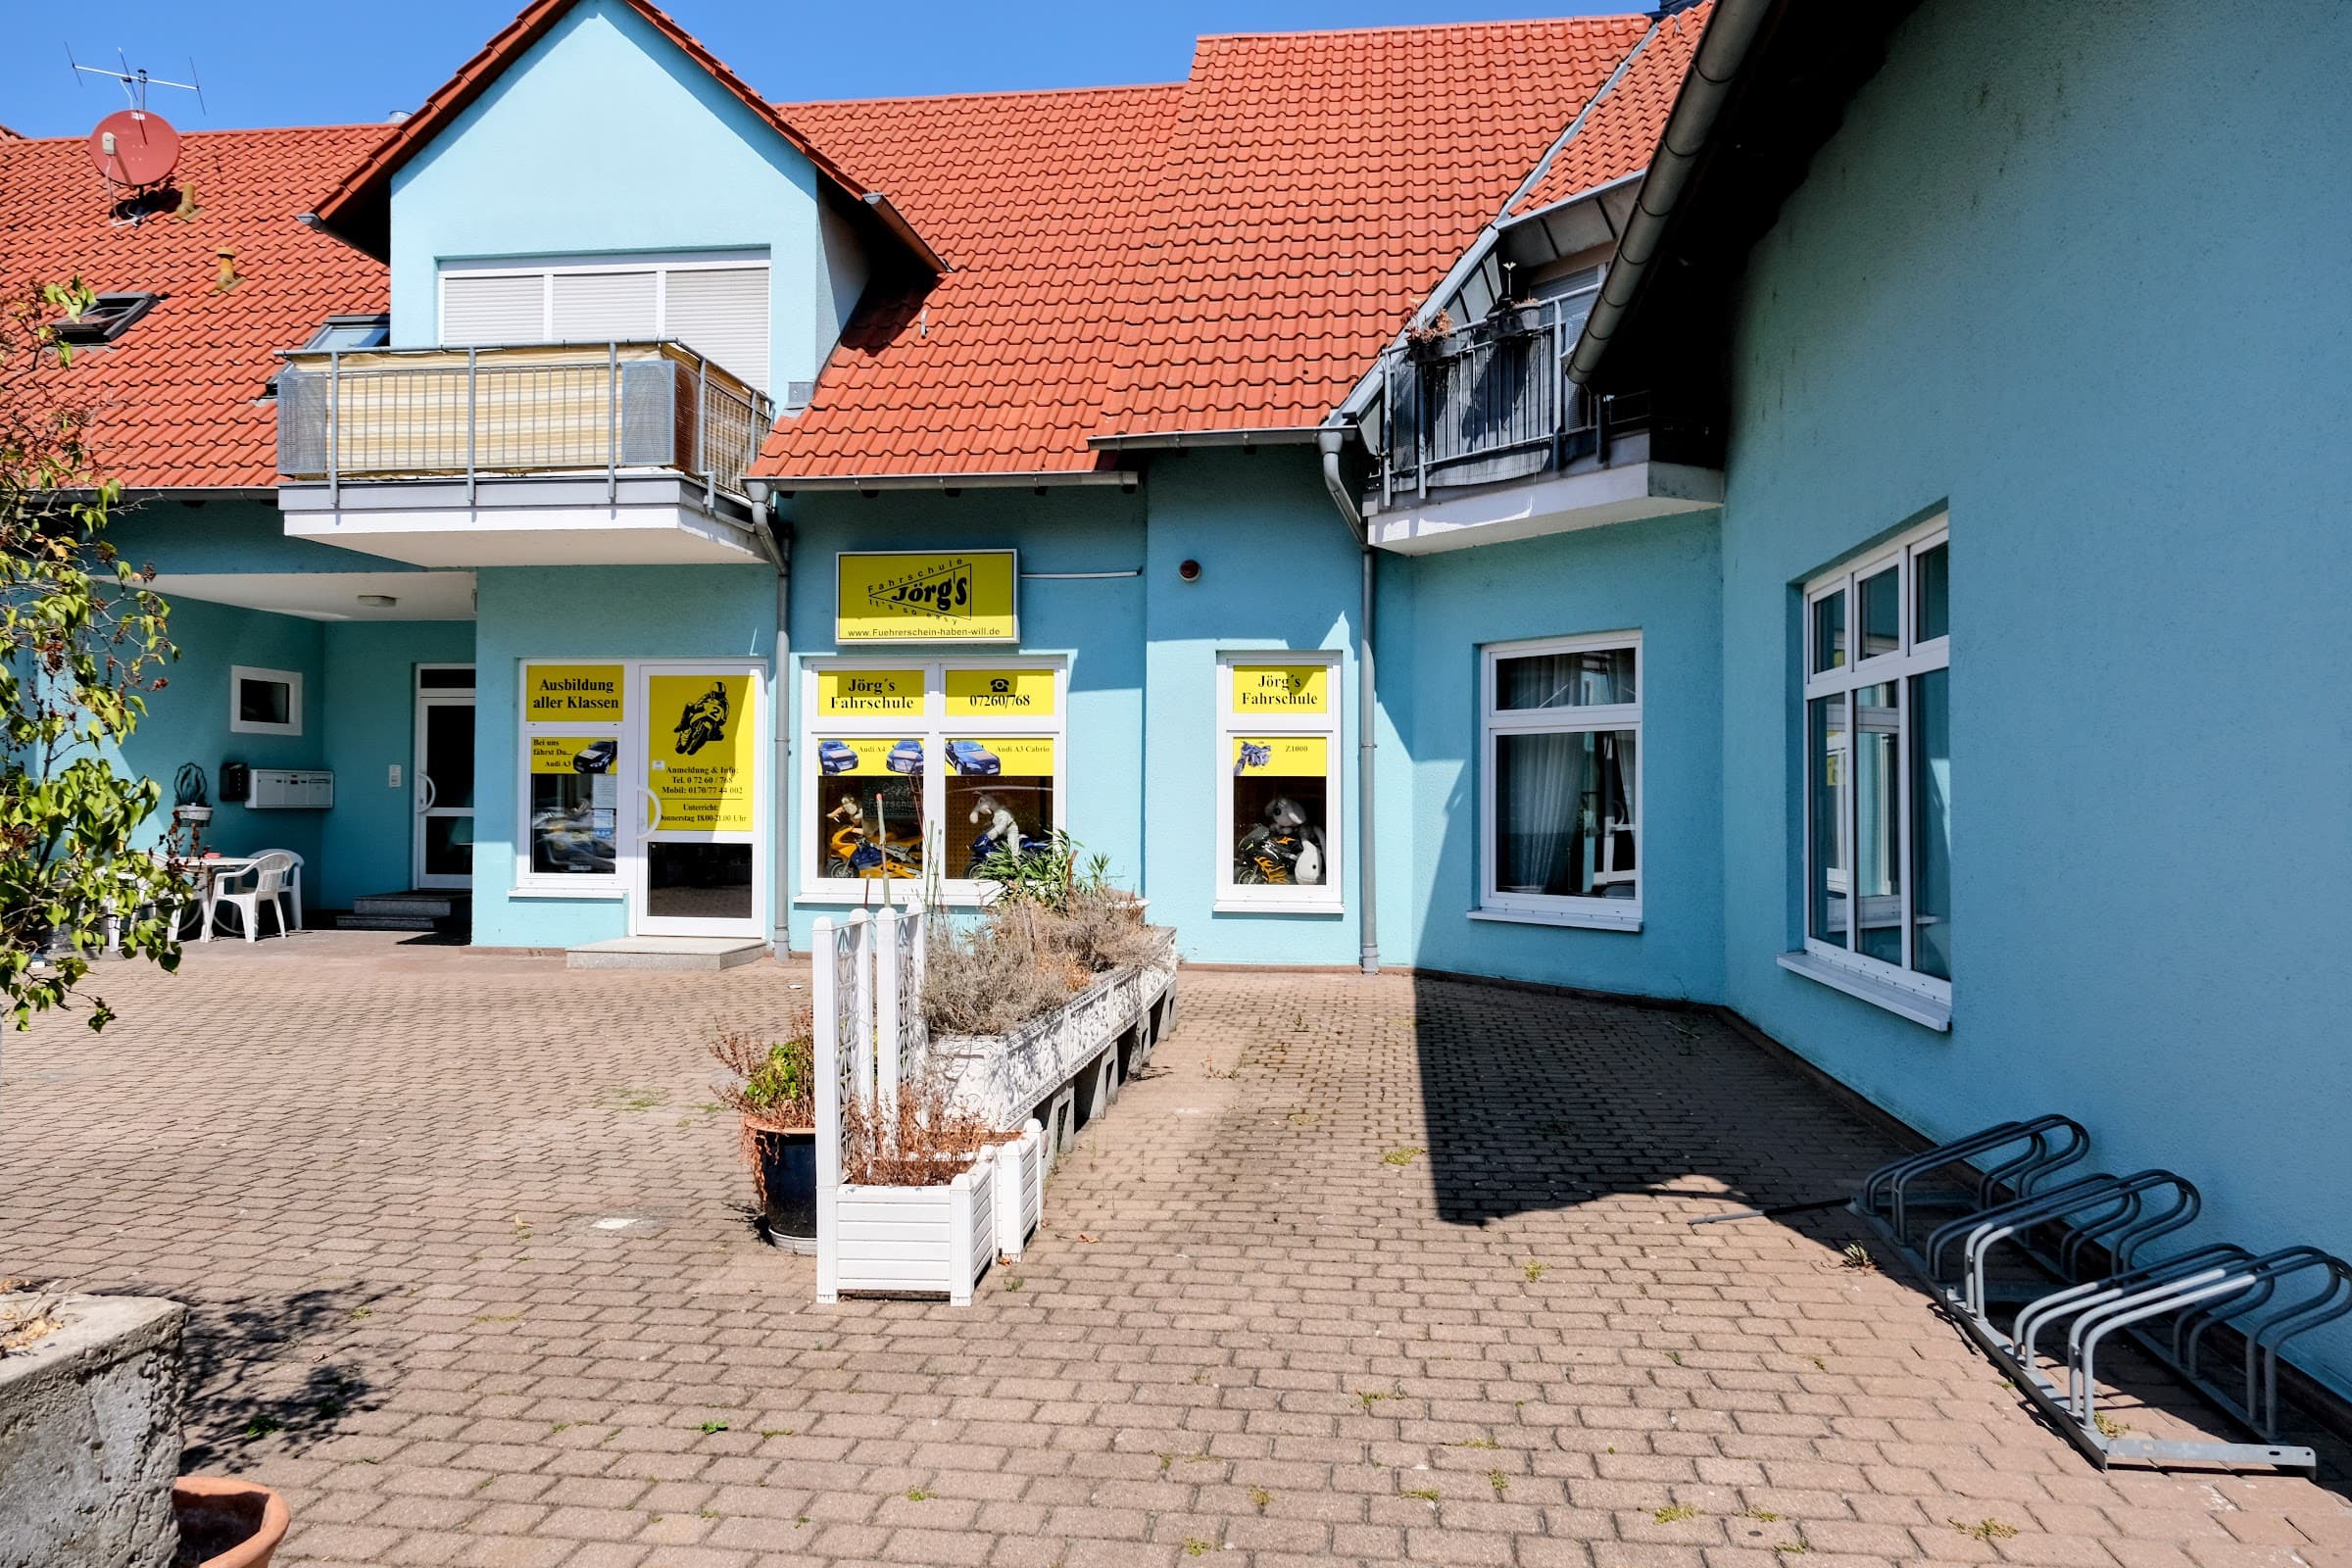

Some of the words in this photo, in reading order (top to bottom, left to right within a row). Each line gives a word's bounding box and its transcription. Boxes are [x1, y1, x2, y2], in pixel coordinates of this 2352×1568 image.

[868, 559, 962, 593] Fahrschule
[903, 608, 917, 616] so
[926, 612, 957, 625] easy
[848, 627, 1001, 637] www.Fuehrerschein-haben-will.de
[539, 678, 614, 693] Ausbildung
[532, 696, 564, 709] aller
[566, 696, 619, 709] Klassen
[830, 696, 914, 709] Fahrschule
[969, 695, 1031, 710] 07260/768
[1242, 692, 1318, 705] Fahrschule
[666, 766, 709, 775] Anmeldung
